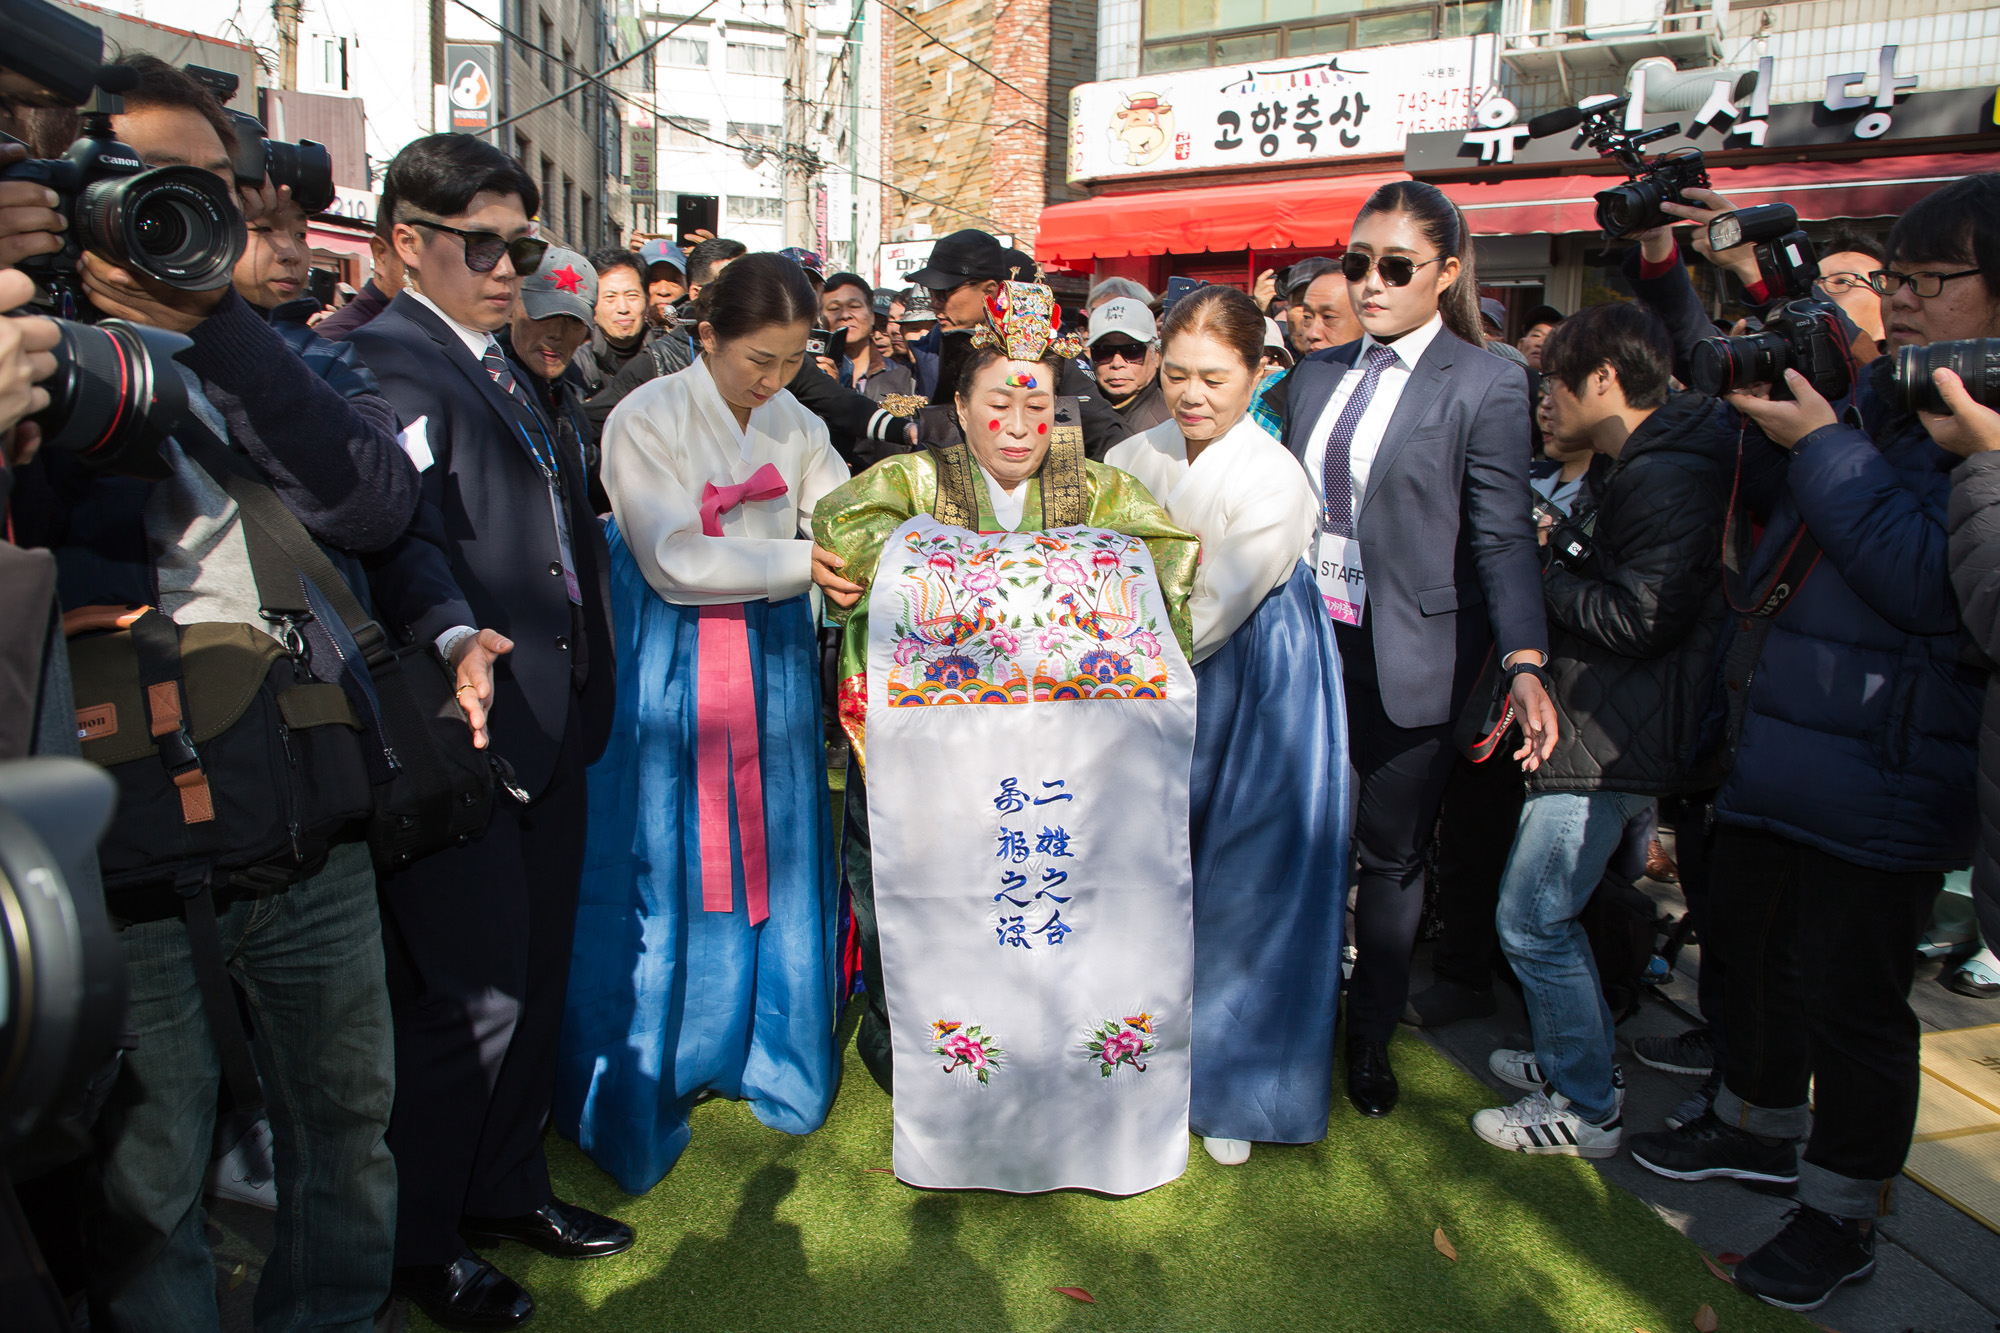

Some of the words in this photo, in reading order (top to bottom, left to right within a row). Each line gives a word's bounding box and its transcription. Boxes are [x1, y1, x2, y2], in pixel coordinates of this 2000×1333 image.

[1397, 86, 1483, 114] 743-4755
[631, 131, 653, 142] OK
[1214, 91, 1371, 158] 고향축산
[98, 154, 140, 167] Canon
[323, 195, 368, 219] 210
[1320, 560, 1365, 586] STAFF
[1754, 583, 1790, 616] Can
